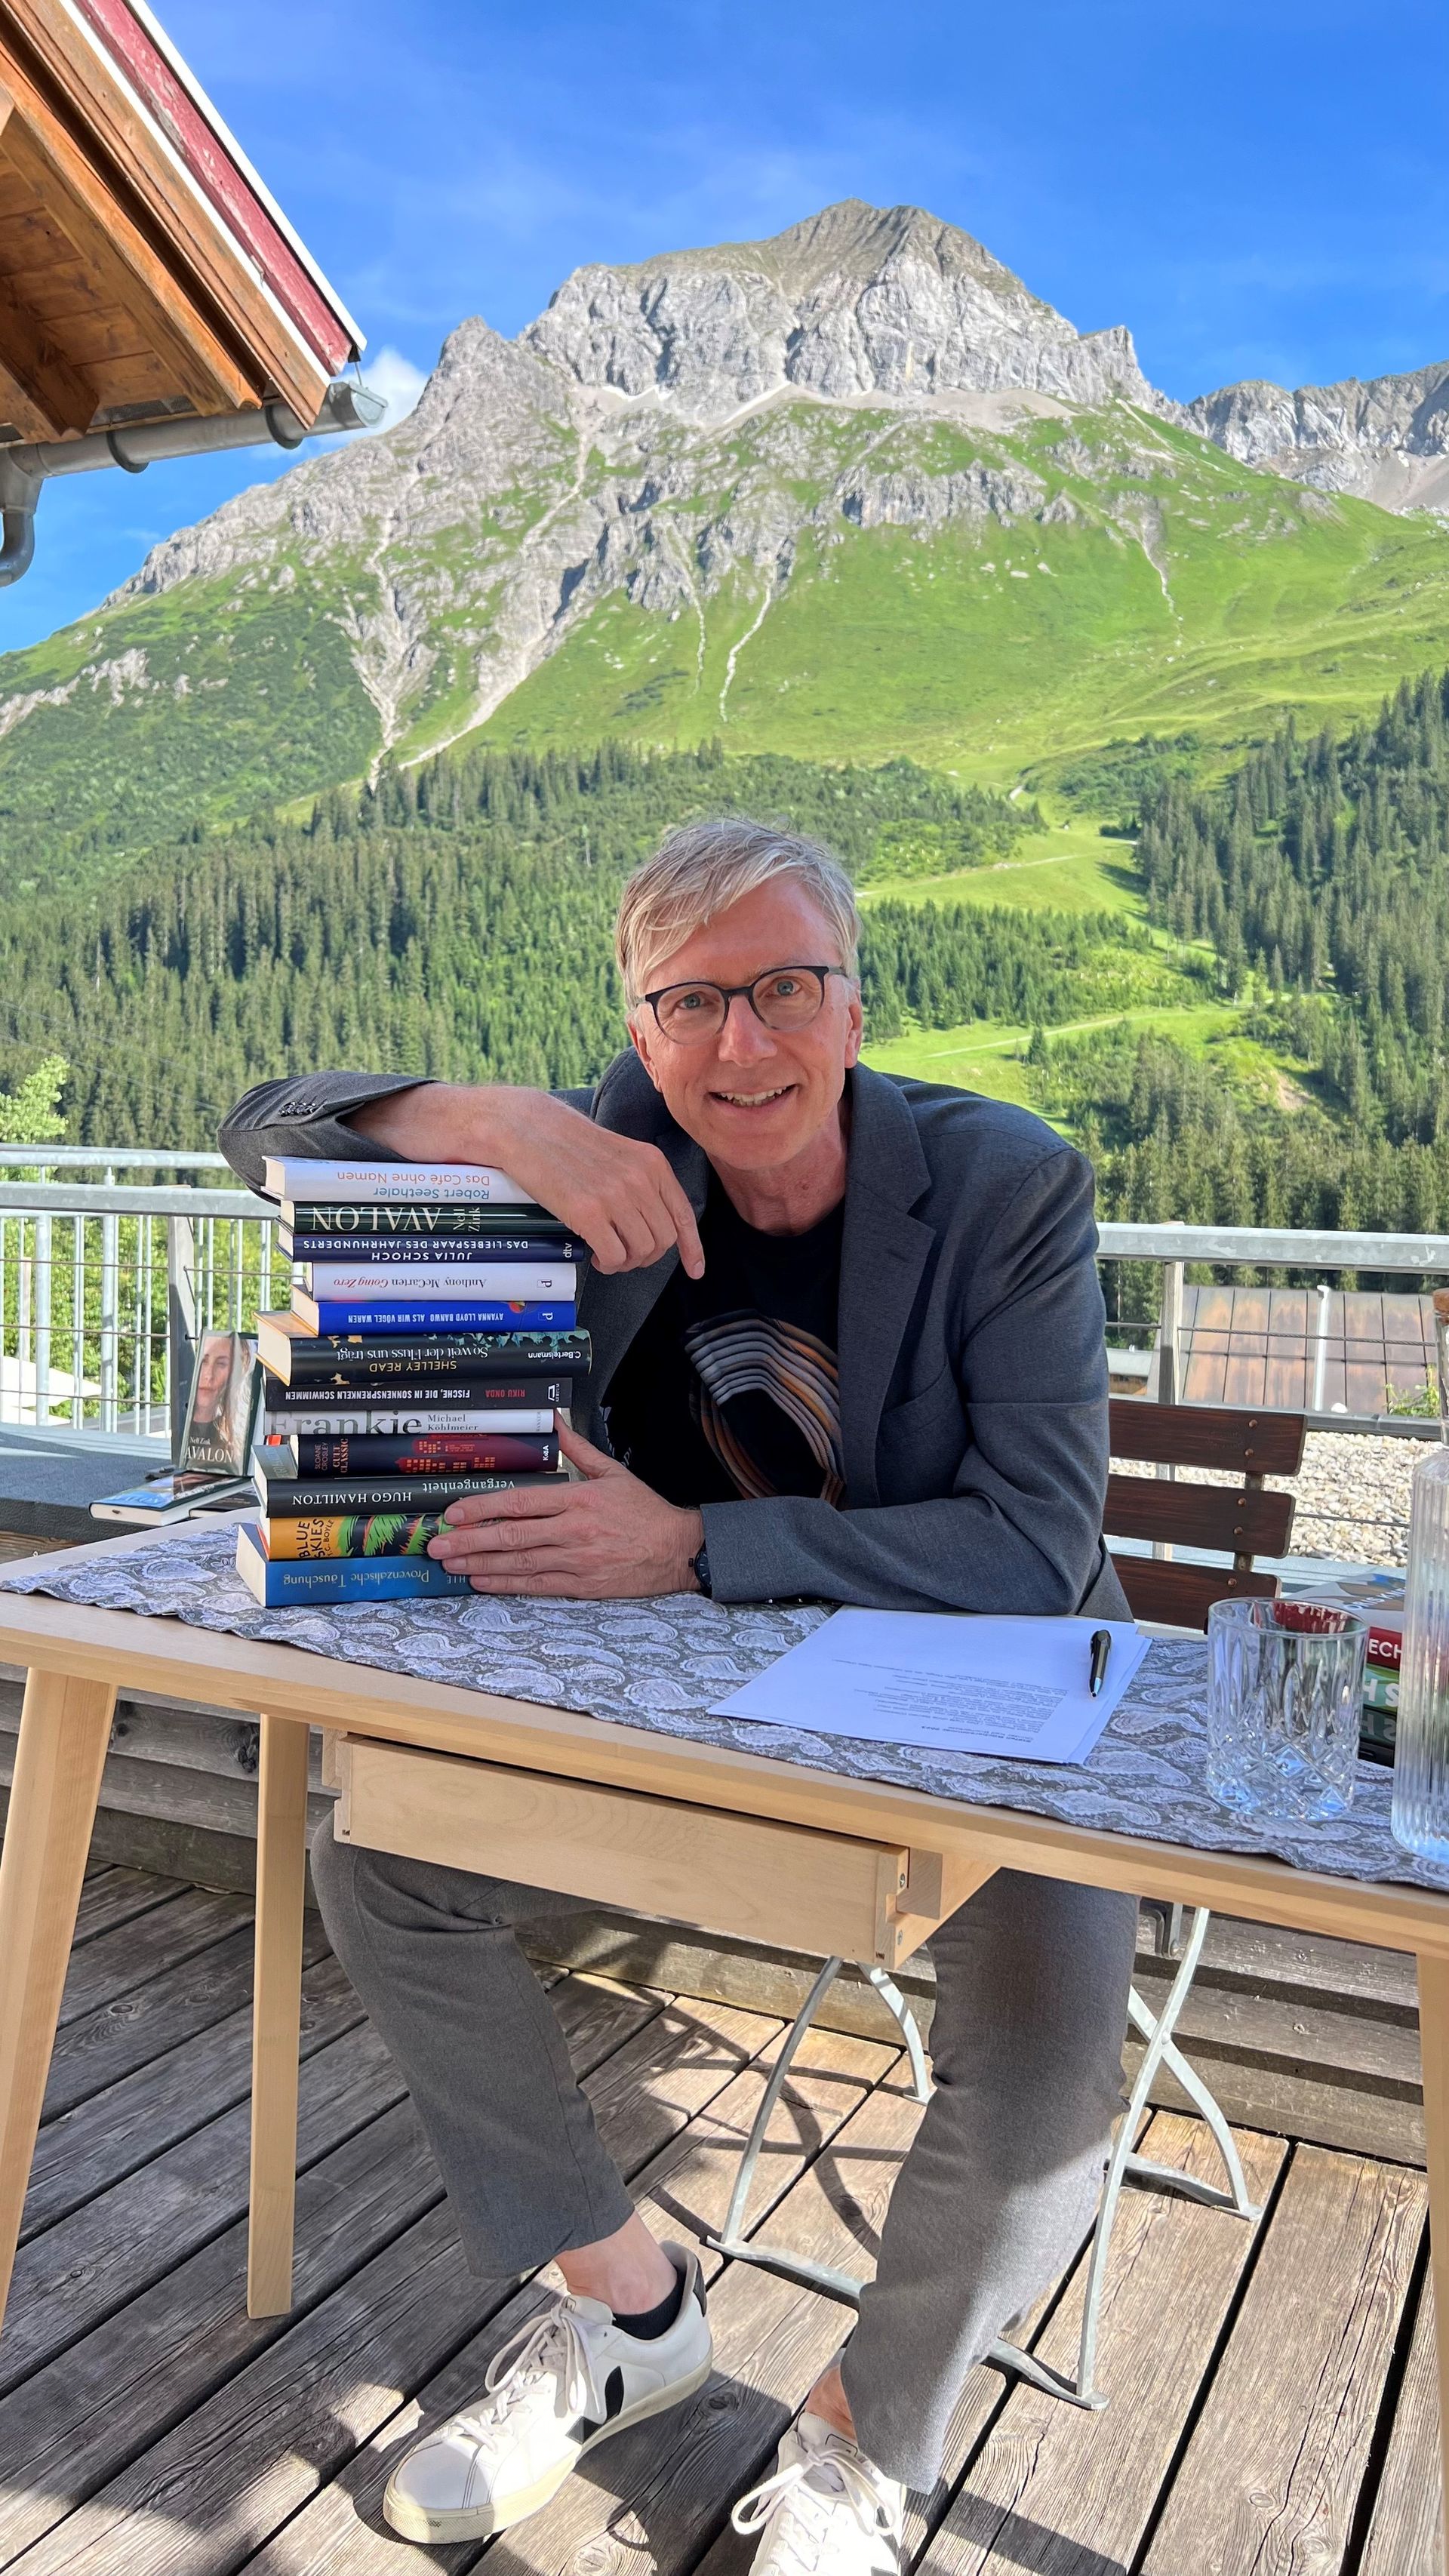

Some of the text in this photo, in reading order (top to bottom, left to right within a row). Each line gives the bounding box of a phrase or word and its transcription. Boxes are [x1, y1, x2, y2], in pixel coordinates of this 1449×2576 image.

[337, 1171, 490, 1186] Das Café ohne Namen
[374, 1187, 490, 1199] Robert Seethaler
[310, 1205, 443, 1232] AVALON
[453, 1208, 465, 1231] Nell
[468, 1207, 481, 1232] Zink
[303, 1240, 528, 1249] DAS LIEBESPAAR DES JAHRHUNDERTS
[562, 1243, 573, 1258] dtv
[371, 1251, 472, 1260] JULIA SCHOCH
[334, 1276, 488, 1288] Anthony McCarten Going Zero
[348, 1315, 372, 1323] WAREN
[374, 1314, 395, 1324] VÖGEL
[398, 1314, 411, 1322] WIR
[413, 1314, 425, 1322] ALS
[429, 1313, 454, 1322] BANWO
[478, 1313, 504, 1321] AYANNA
[337, 1347, 363, 1361] trägt
[368, 1350, 389, 1360] uns
[392, 1348, 421, 1361] Fluss
[425, 1347, 444, 1360] der
[448, 1347, 472, 1358] weit
[369, 1361, 457, 1372] SHELLEY READ
[285, 1389, 470, 1400] FISCHE, DIE IN SONNENSPRENKELN SCHWIMMEN
[485, 1389, 525, 1398] RIKU ONDA
[270, 1410, 422, 1434] Frankie
[186, 1445, 232, 1463] AVALON
[340, 1438, 349, 1473] CLASSIC
[292, 1492, 411, 1505] HUGO HAMILTON
[323, 1519, 334, 1543] BOYLE
[297, 1520, 311, 1558] BLUE
[311, 1519, 326, 1558] SKIES
[283, 1570, 429, 1588] Provenzalische Täuschung
[447, 1575, 466, 1583] HIE
[1367, 1638, 1402, 1660] ECH
